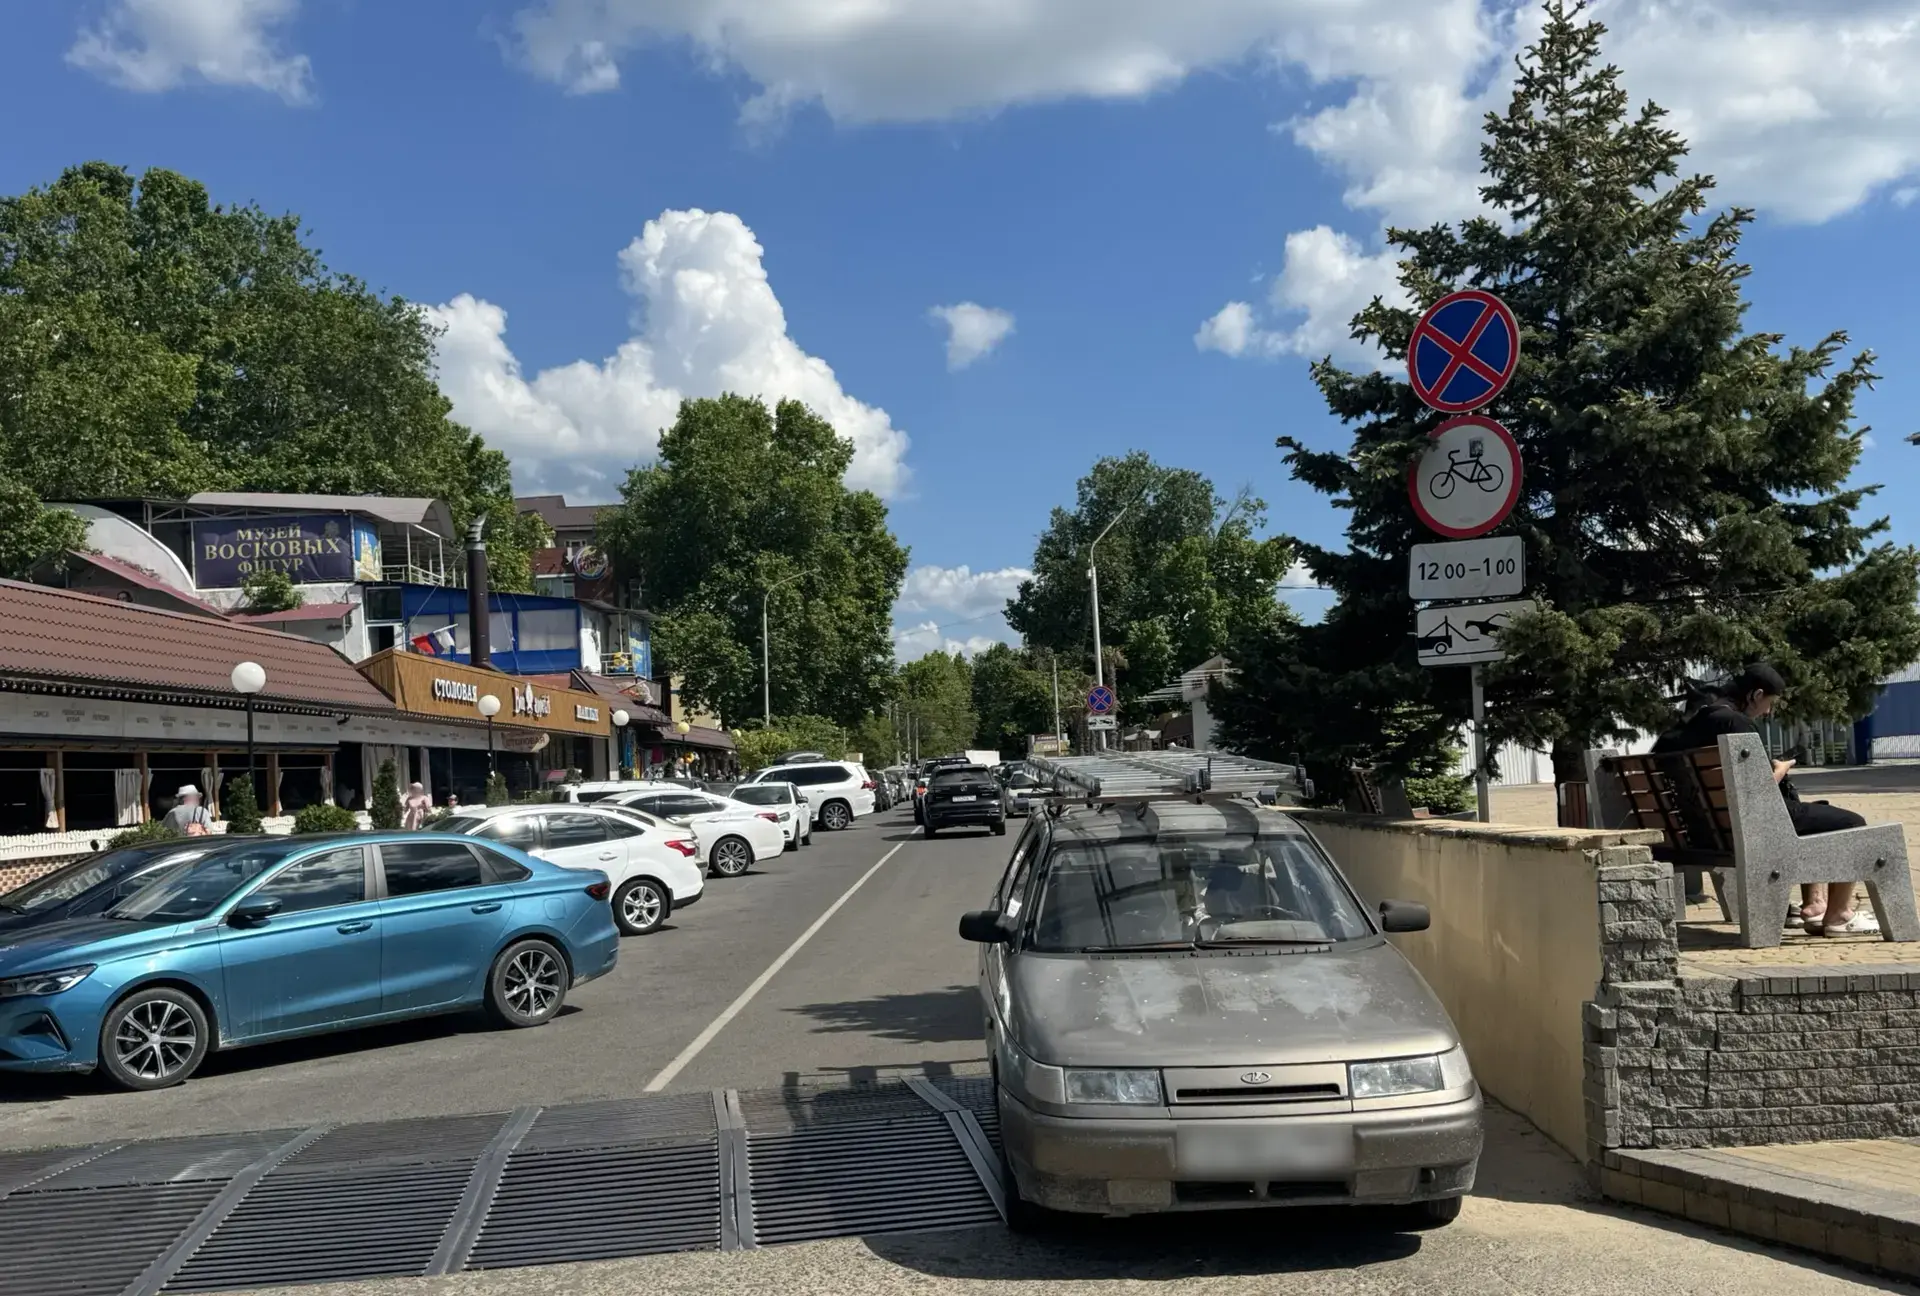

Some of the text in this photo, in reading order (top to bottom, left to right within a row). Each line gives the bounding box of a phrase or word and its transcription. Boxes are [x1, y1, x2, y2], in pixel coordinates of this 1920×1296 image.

[236, 522, 301, 541] МУЗЕЙ
[204, 538, 341, 560] ВОСКОВЫХ
[237, 558, 303, 574] ФИГУР
[434, 678, 478, 703] СТОЛОВАЯ
